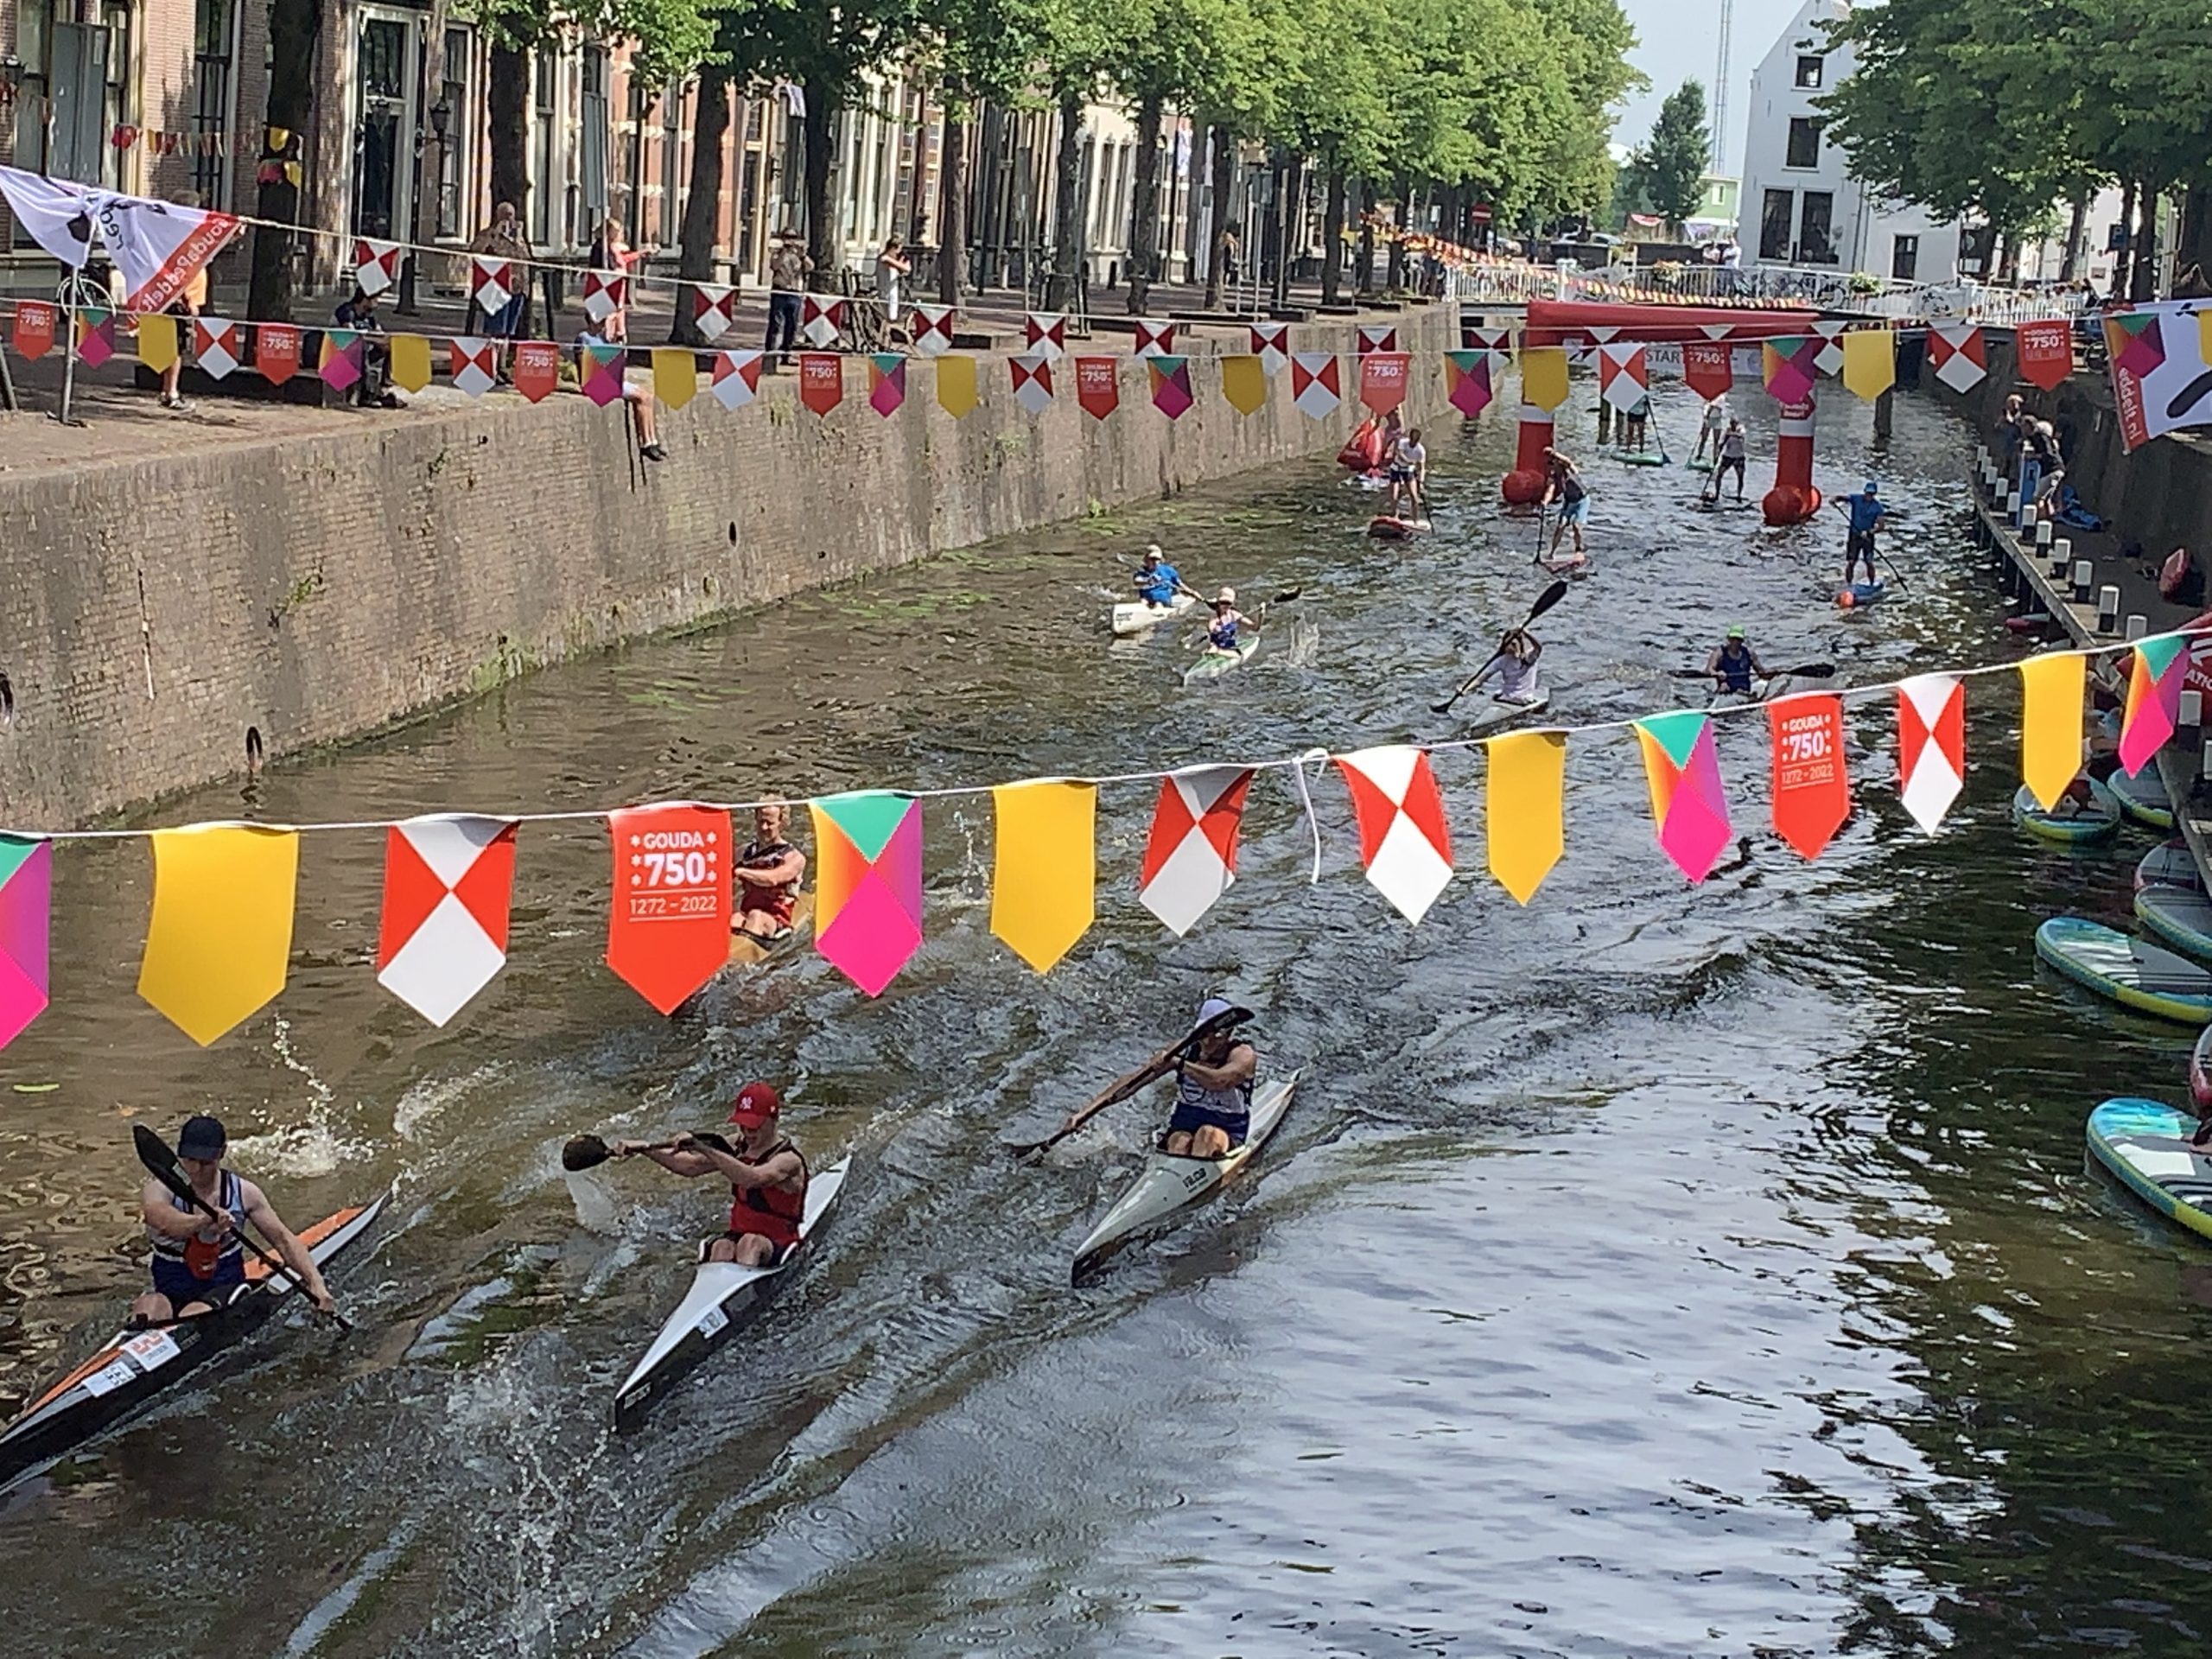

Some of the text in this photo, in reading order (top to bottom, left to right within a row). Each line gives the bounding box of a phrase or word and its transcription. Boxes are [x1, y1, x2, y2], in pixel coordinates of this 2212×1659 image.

[2031, 334, 2060, 349] 750
[1645, 349, 1684, 364] STAR
[1694, 352, 1719, 364] 750
[1373, 365, 1399, 377] 750
[1789, 714, 1825, 733] GOUDA
[1789, 730, 1825, 761] 750
[1781, 768, 1803, 785] 1272
[1809, 763, 1834, 780] 2022
[643, 830, 705, 850] GOUDA
[643, 851, 706, 887] 750
[629, 898, 667, 915] 1272
[679, 894, 717, 913] 2022
